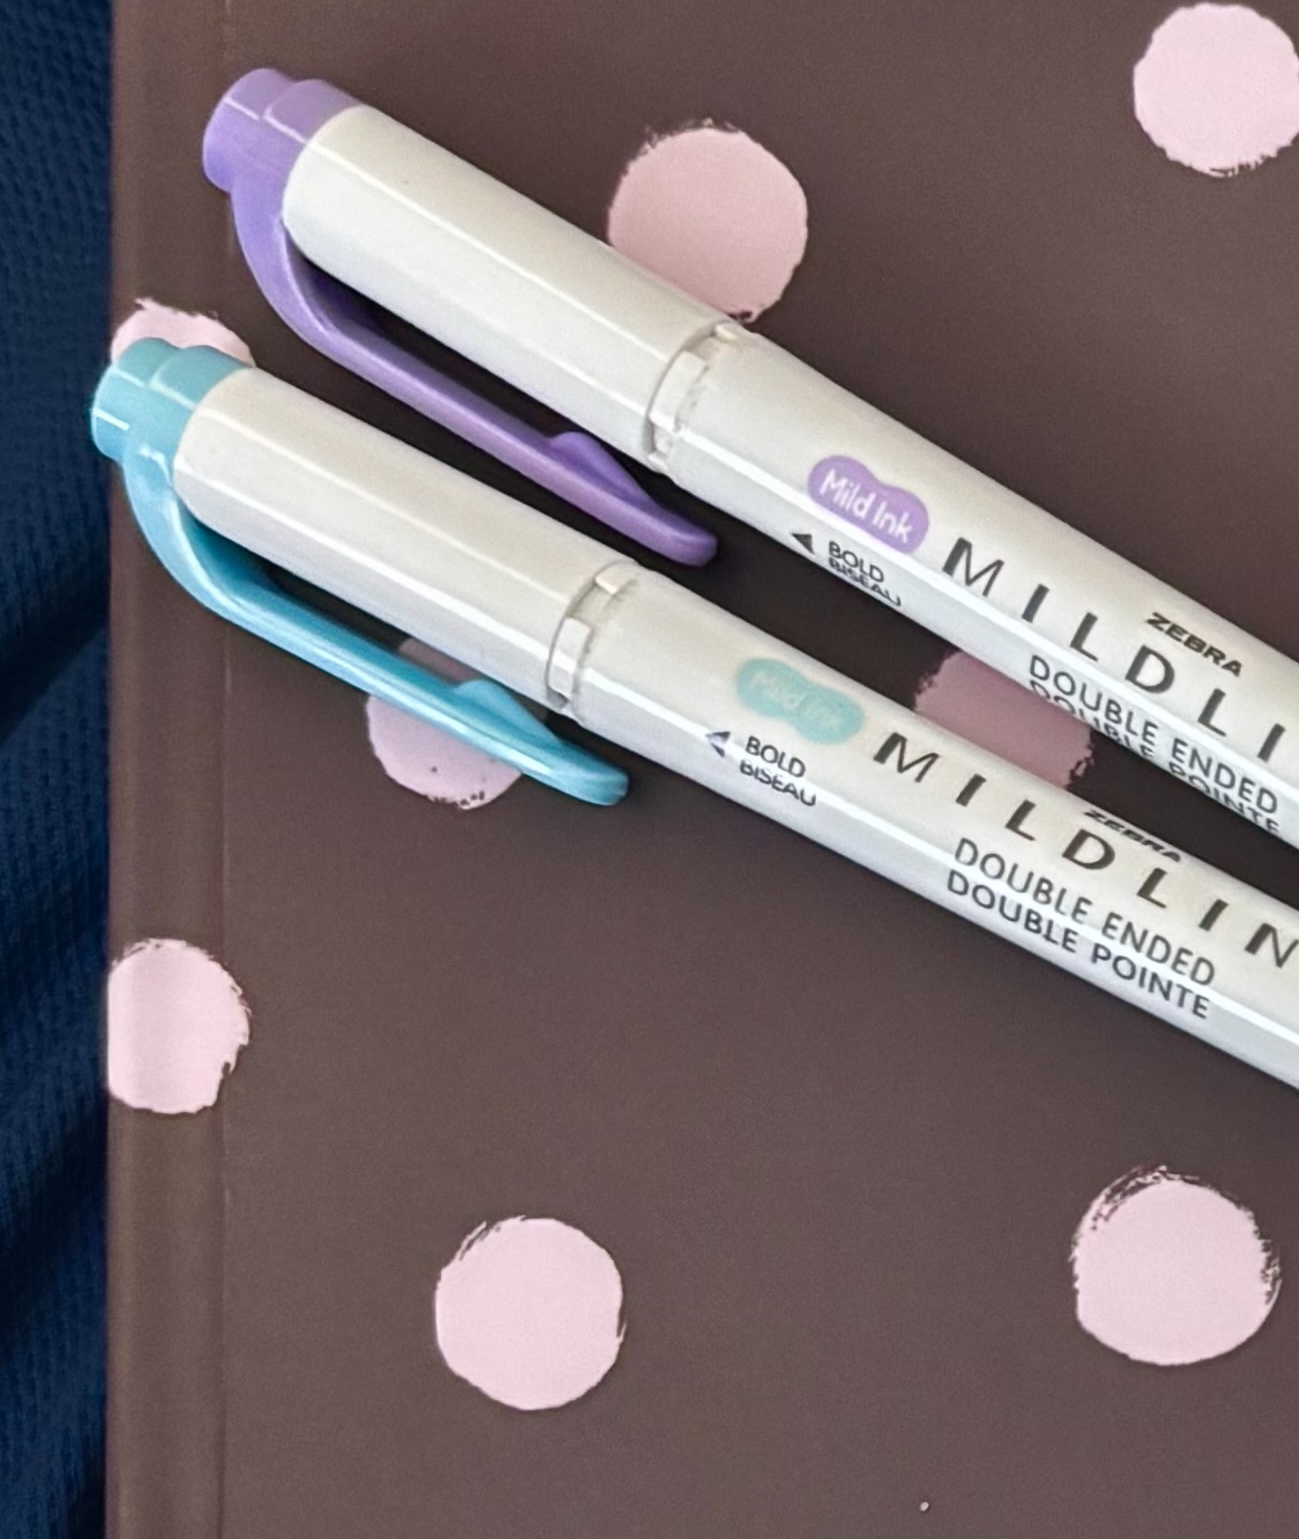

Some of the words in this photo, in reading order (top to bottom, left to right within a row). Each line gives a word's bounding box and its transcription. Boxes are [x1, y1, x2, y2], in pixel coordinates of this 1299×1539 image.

[819, 468, 876, 519] Mild
[872, 500, 913, 545] Ink
[828, 541, 885, 583] BOLD
[828, 557, 902, 607] BISEAU
[1146, 612, 1243, 678] ZEBRA
[745, 736, 806, 778] BOLD
[1030, 654, 1159, 747] DOUBLE
[1172, 737, 1278, 814] ENDED
[739, 760, 817, 807] BISEAU
[947, 869, 1080, 954] DOUBLE
[1091, 943, 1210, 1019] POINTE
[954, 838, 1093, 924] DOUBLE
[1101, 911, 1215, 986] ENDED
